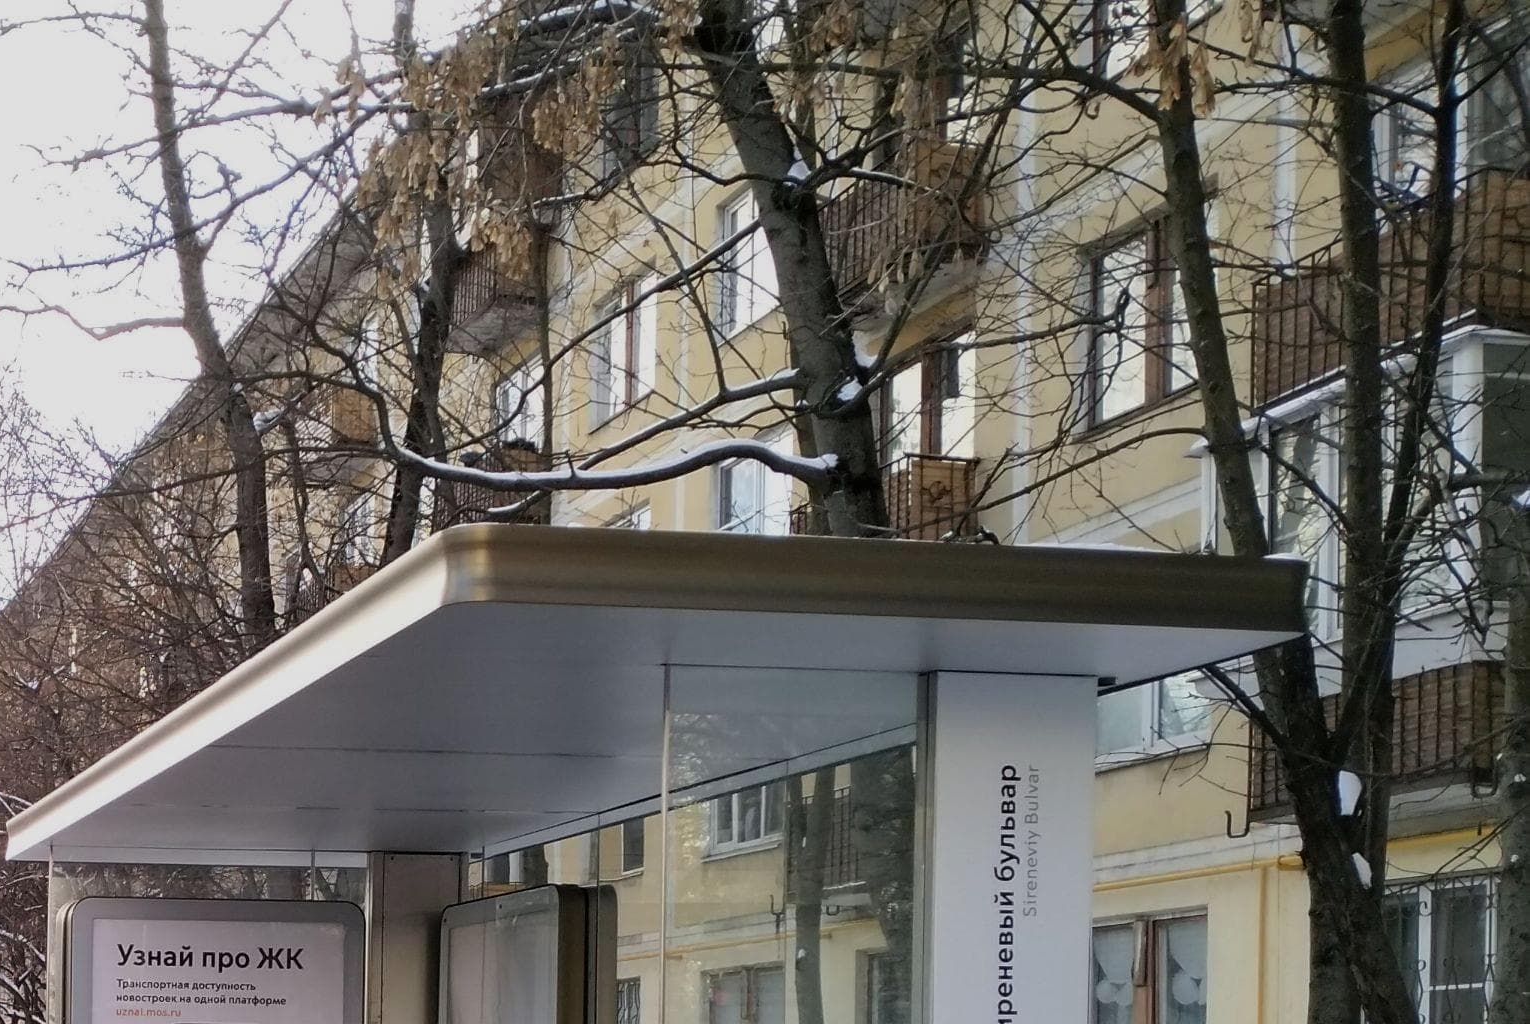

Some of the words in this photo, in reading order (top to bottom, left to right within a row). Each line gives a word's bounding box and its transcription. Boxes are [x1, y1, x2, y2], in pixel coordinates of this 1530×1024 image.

[1023, 765, 1040, 824] Bulvar
[994, 764, 1021, 882] бульвар
[1022, 831, 1042, 917] Sireneviy
[117, 944, 193, 967] Узнай
[202, 950, 250, 973] про
[256, 947, 304, 970] ЖК
[116, 978, 190, 990] Транспортная
[192, 981, 257, 992] доступность
[116, 993, 177, 1004] новостроек
[194, 996, 226, 1005] одной
[228, 996, 287, 1007] платформе
[116, 1007, 182, 1018] uznai.mos.ru
